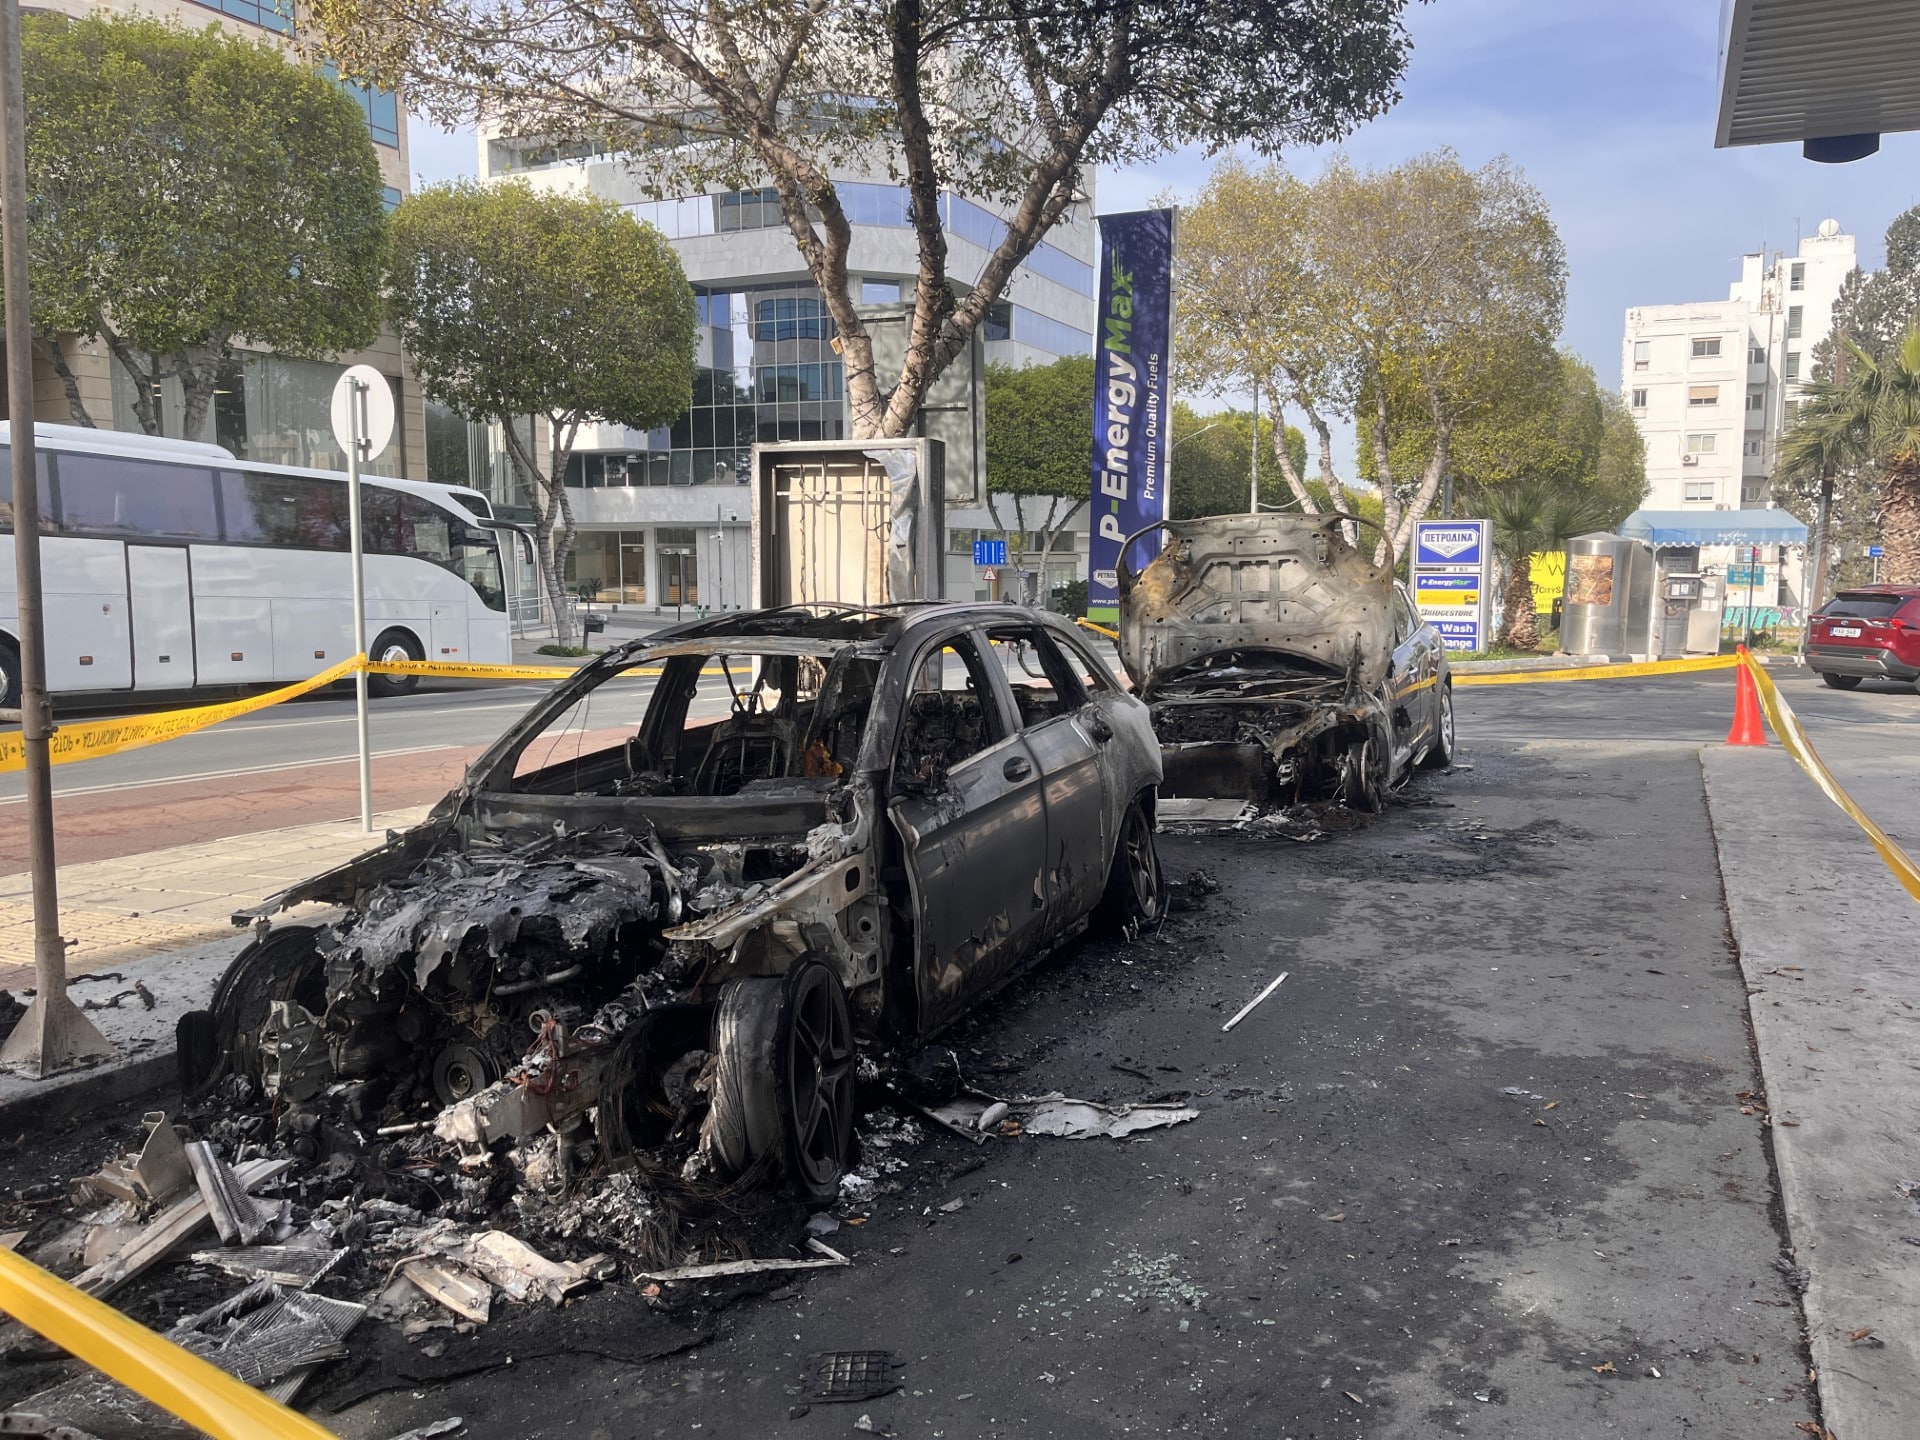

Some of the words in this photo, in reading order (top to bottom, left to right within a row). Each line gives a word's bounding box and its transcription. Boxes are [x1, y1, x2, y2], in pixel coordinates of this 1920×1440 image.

[1147, 353, 1159, 390] Fuels
[1099, 236, 1137, 543] P-EnergyMax
[1146, 391, 1160, 438] Quality
[1143, 442, 1157, 500] Premium
[1424, 533, 1473, 543] ΠΕΤΡΟΛΙΝΑ
[1420, 608, 1474, 617] BRIDGESTONE
[1441, 623, 1474, 633] Wash
[1441, 638, 1473, 649] hange
